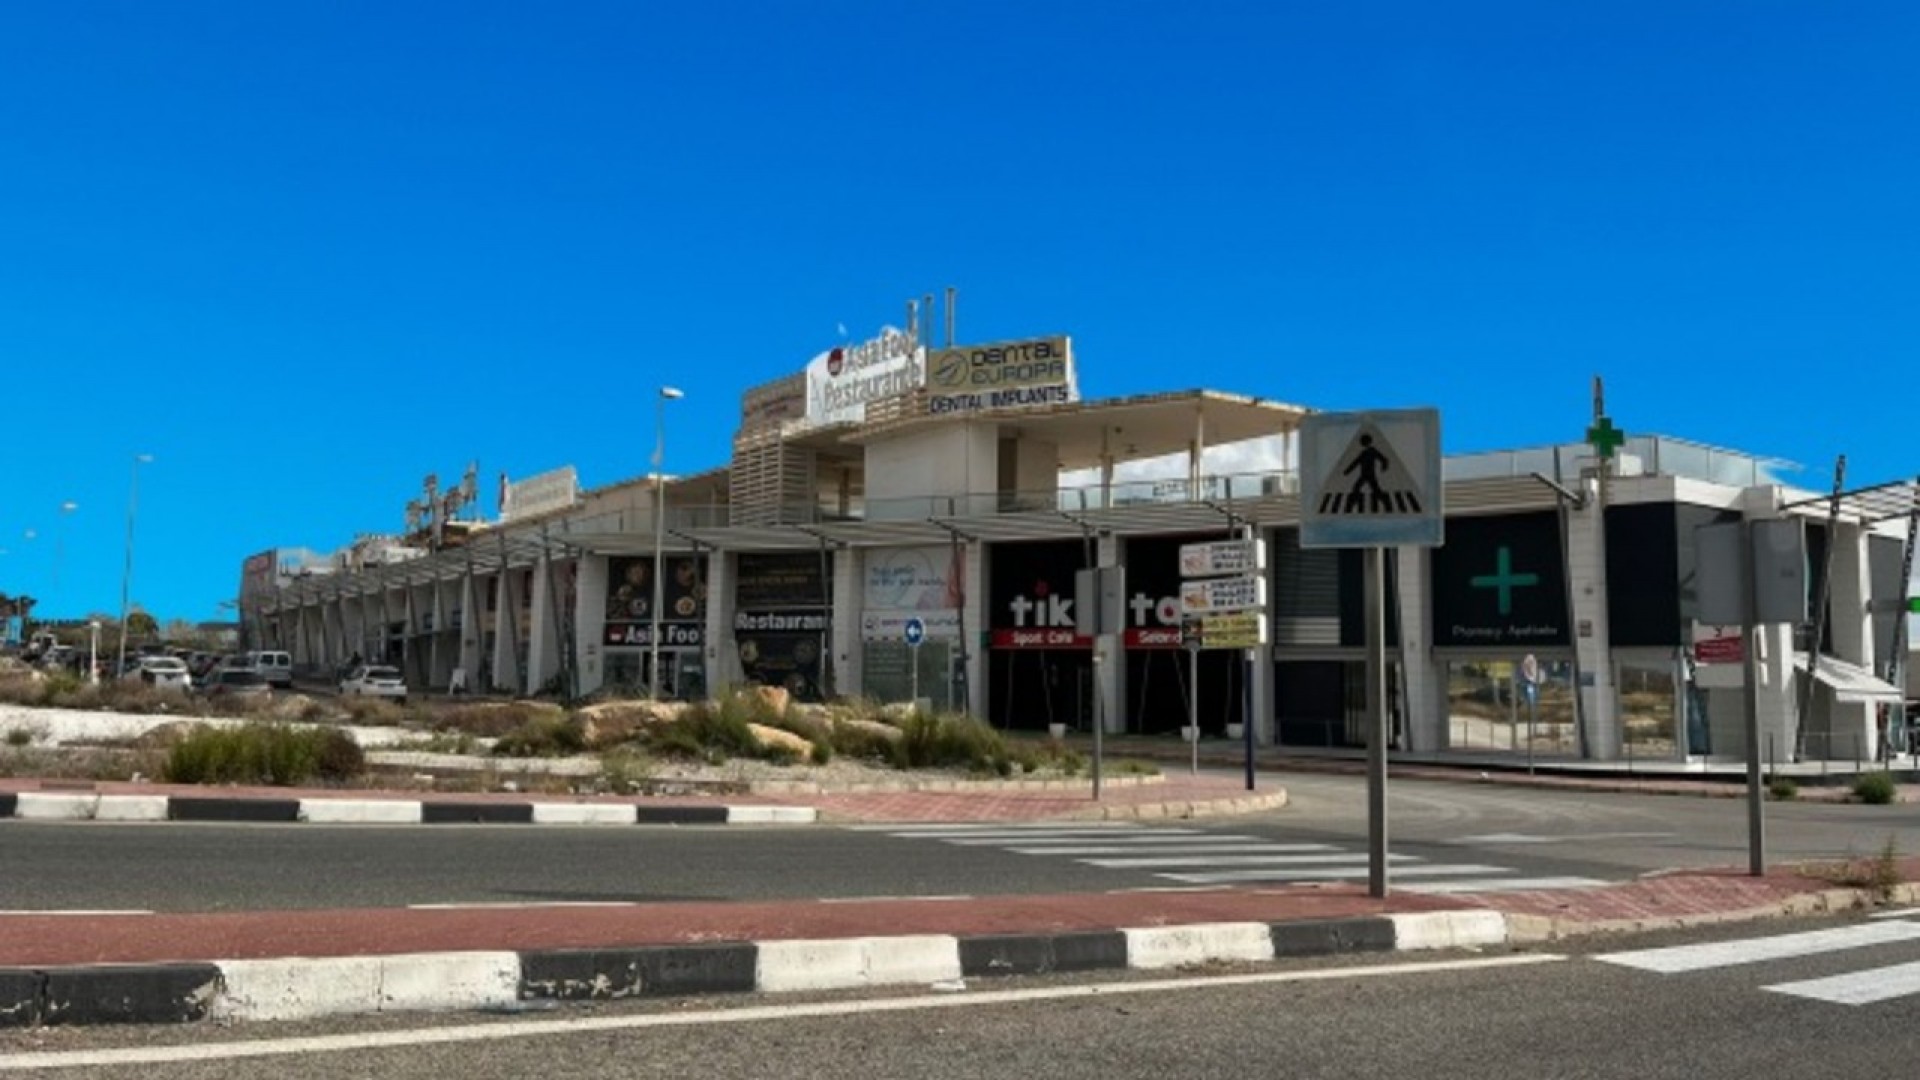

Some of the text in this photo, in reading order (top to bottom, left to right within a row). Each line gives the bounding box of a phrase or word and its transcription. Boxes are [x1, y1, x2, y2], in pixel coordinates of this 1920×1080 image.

[930, 386, 1069, 413] DENTAL IMPLANTS
[735, 612, 830, 630] Restauran
[668, 625, 704, 643] Foo
